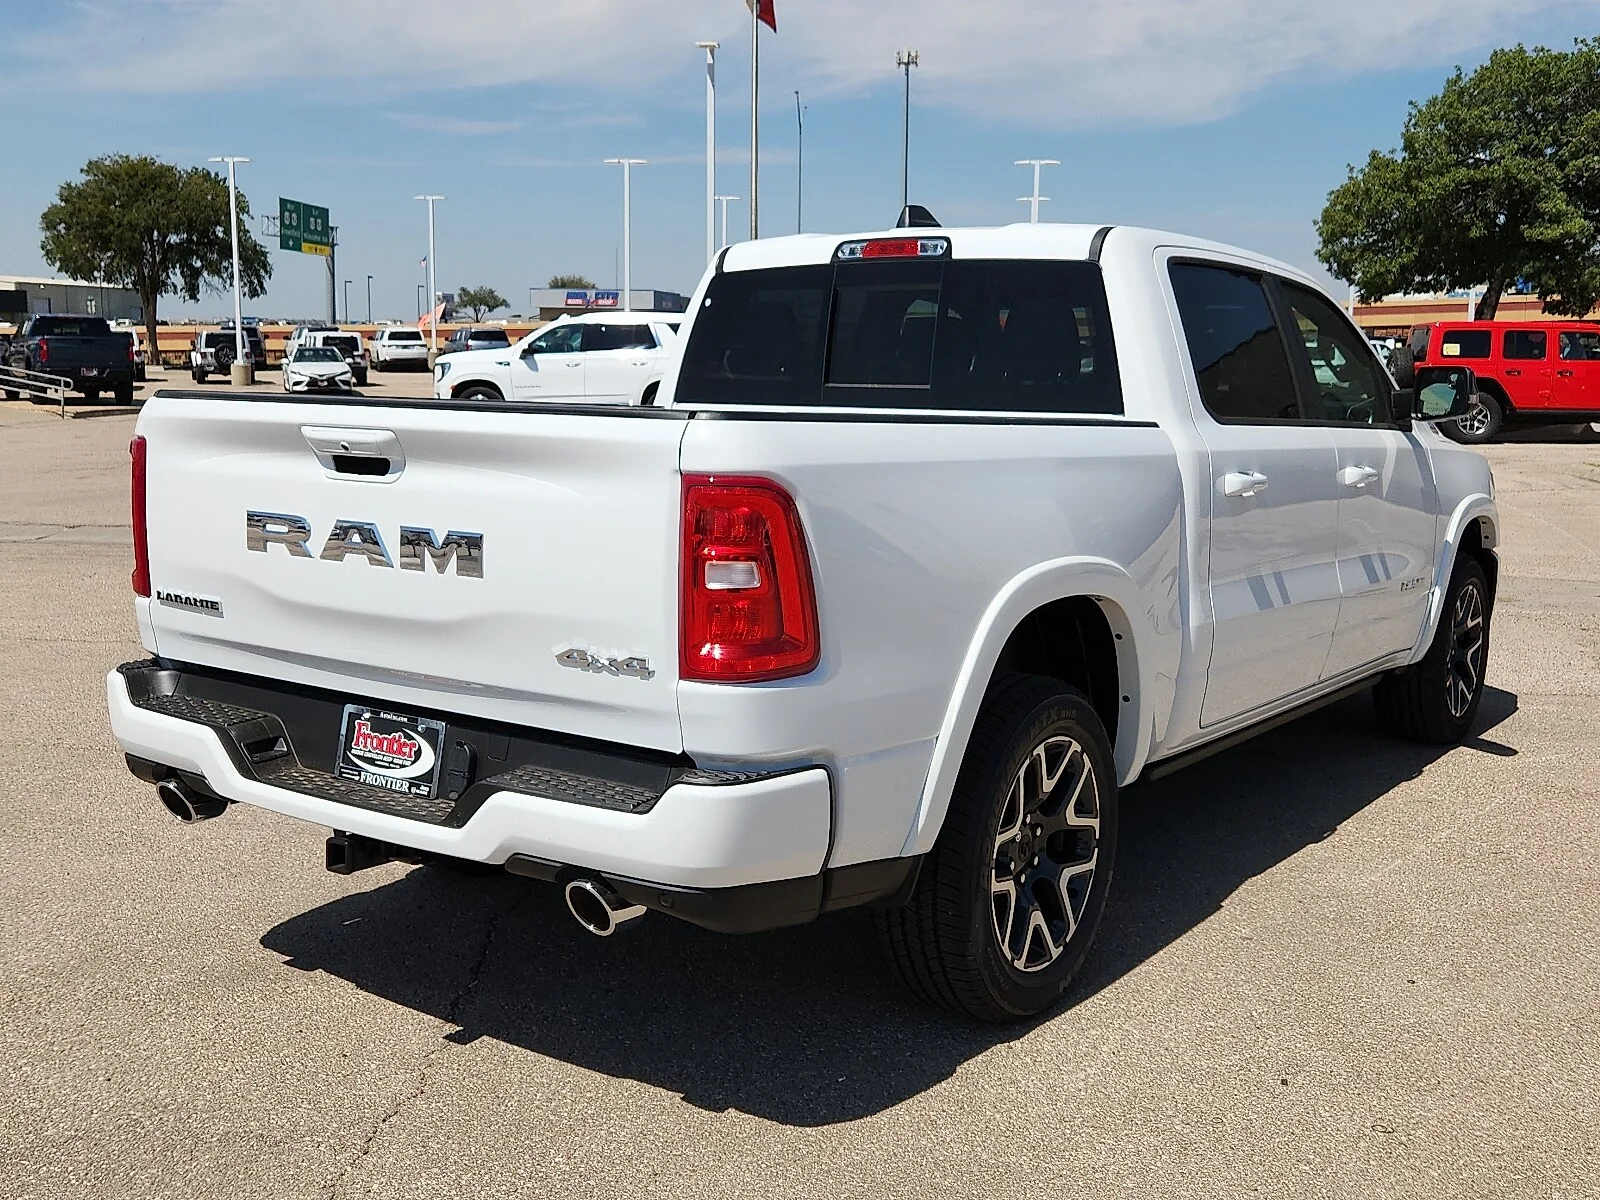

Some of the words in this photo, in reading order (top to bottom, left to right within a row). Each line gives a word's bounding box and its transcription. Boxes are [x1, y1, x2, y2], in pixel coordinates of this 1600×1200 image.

[246, 509, 484, 579] RAM
[156, 590, 221, 612] LARAMIE
[352, 720, 418, 759] Frontier
[360, 771, 409, 793] FRONTIER
